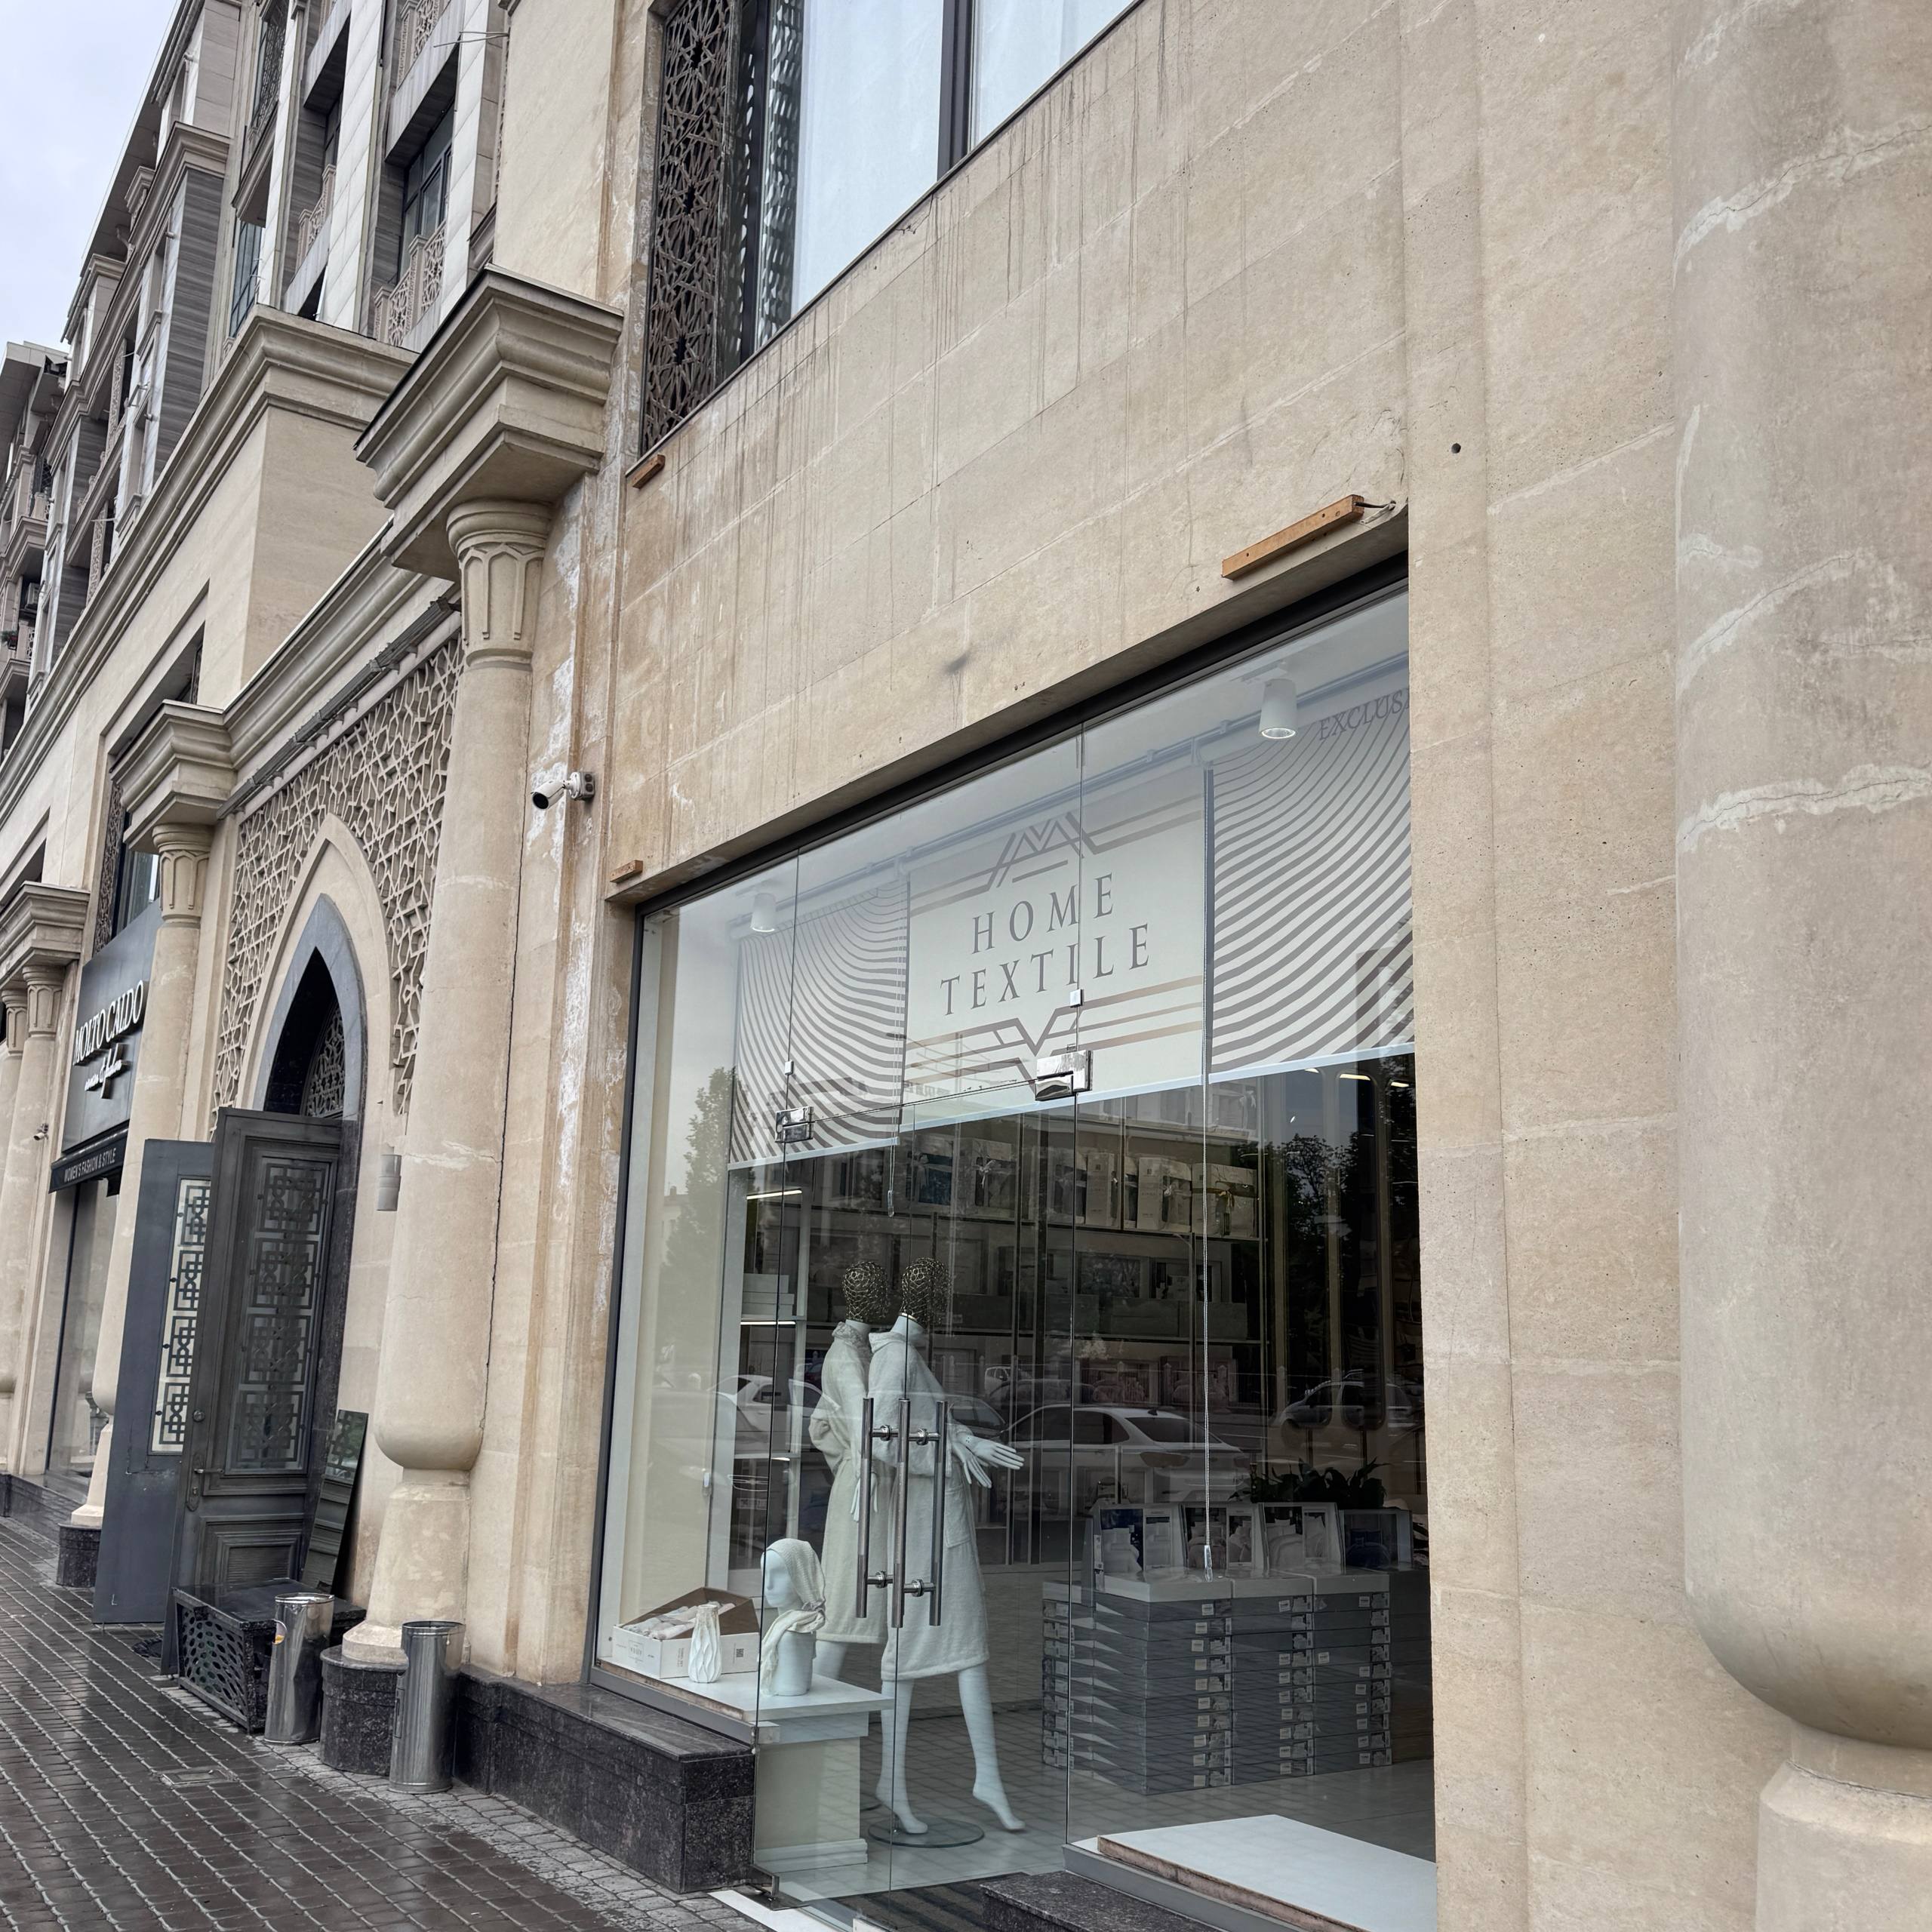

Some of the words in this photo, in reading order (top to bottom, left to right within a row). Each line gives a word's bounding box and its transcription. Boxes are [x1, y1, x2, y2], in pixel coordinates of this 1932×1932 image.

[971, 872, 1113, 954] HOME
[940, 923, 1149, 1016] TEXTILE
[73, 1008, 106, 1066] MOLTO
[106, 980, 143, 1043] CALDO
